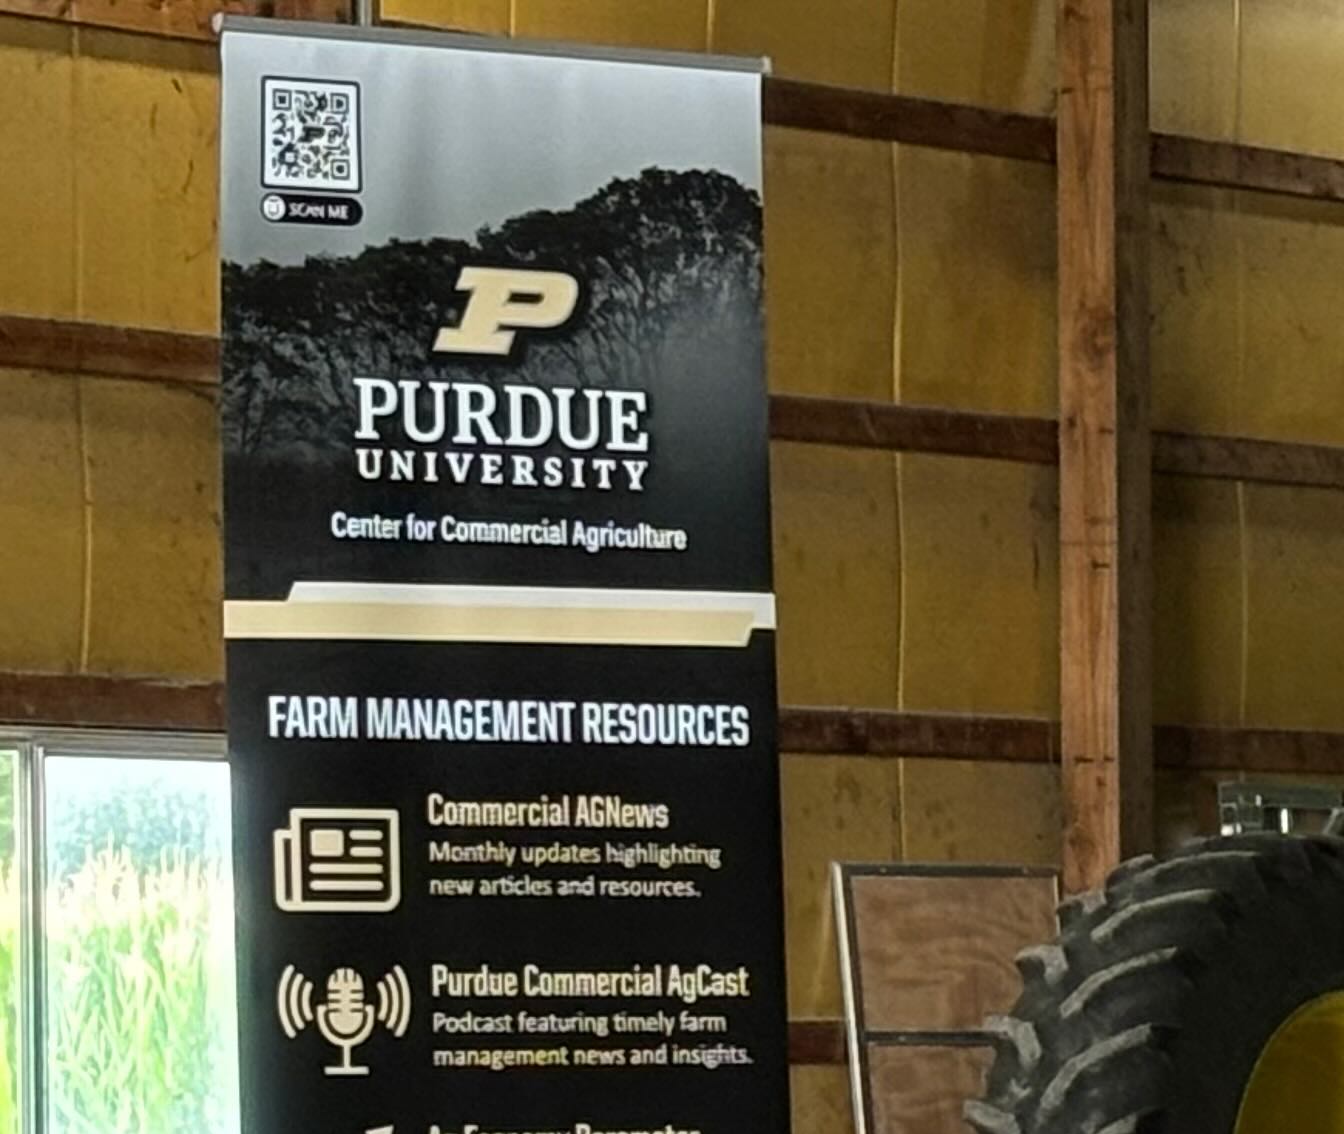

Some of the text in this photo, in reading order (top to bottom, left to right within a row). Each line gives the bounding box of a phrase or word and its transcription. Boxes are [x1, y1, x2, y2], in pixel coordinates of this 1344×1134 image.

[327, 204, 349, 220] ME
[432, 266, 579, 355] P
[352, 377, 649, 453] PURDUE
[355, 447, 649, 491] UNIVERSITY
[330, 511, 688, 553] Center for Commercial Agriculture
[268, 695, 750, 746] FARM MANAGEMENT RESOURCES
[427, 792, 669, 829] Commercial AGNews
[428, 840, 722, 870] Monthly updates highlighting
[429, 874, 701, 897] new articles and resources.
[431, 963, 750, 1004] Purdue Commercial AgCast
[432, 1010, 727, 1037] Podcast featuring timely farm
[433, 1043, 753, 1071] management news and insights.
